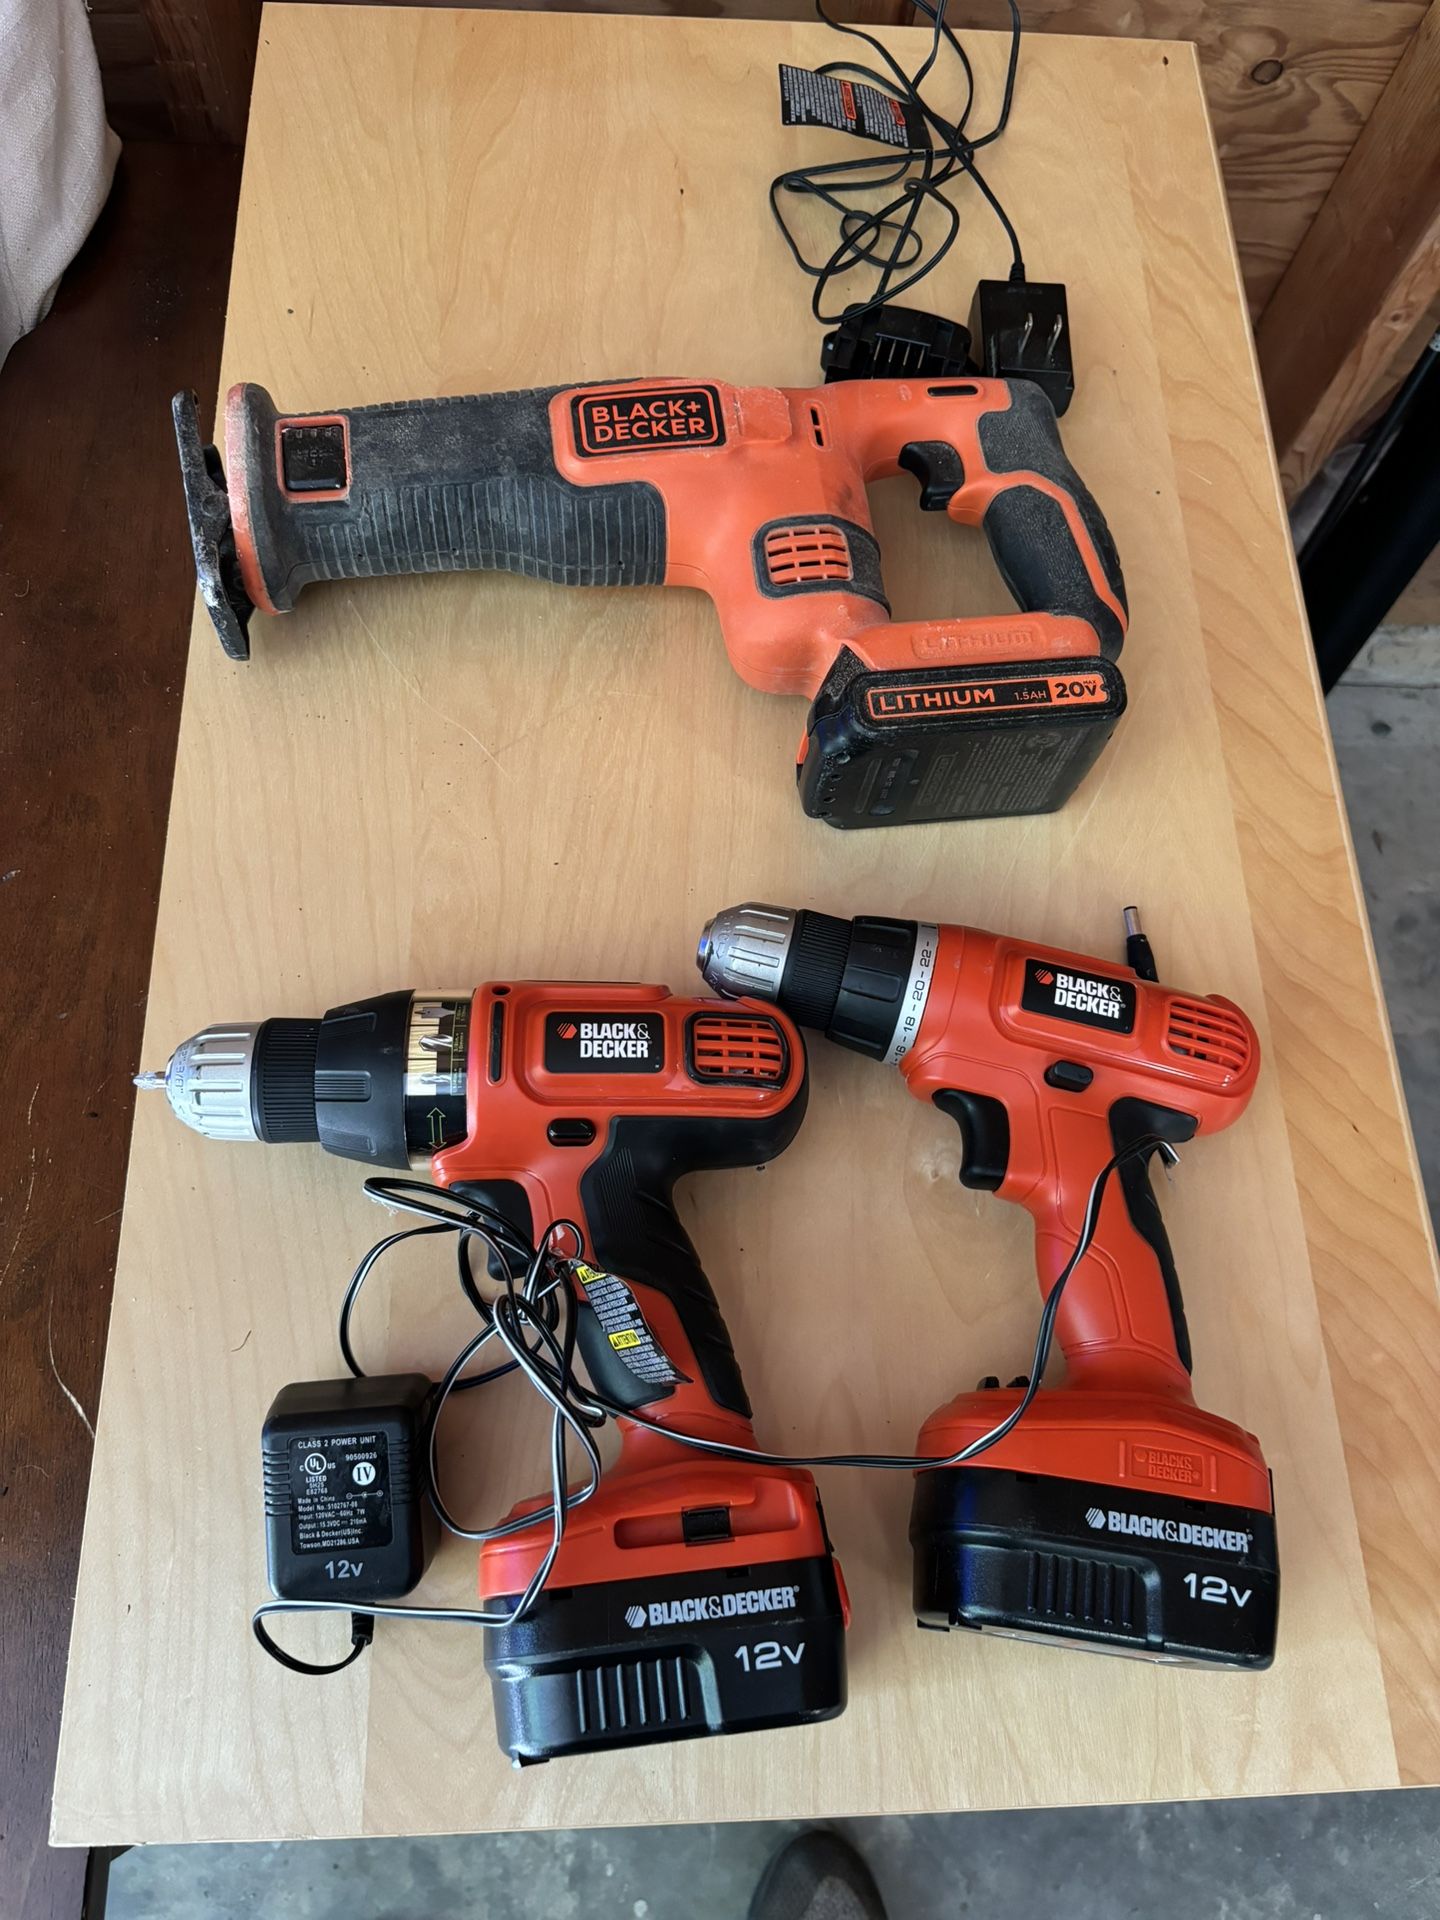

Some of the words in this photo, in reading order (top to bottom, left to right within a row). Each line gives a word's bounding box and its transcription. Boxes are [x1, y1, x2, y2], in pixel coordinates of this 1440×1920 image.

[591, 399, 701, 424] BLACK+
[594, 417, 707, 443] DECKER
[879, 687, 996, 712] LITHIUM
[1013, 690, 1047, 702] 1.5AH
[903, 1016, 916, 1033] 18
[912, 979, 926, 1002] 20
[919, 949, 932, 968] 22
[1053, 988, 1120, 1020] DECKER
[580, 1040, 649, 1058] DECKER
[297, 1440, 321, 1449] CLASS
[323, 1439, 329, 1447] 2
[331, 1437, 357, 1446] POWER
[359, 1435, 377, 1444] UNIT
[305, 1475, 327, 1484] LISTED
[1148, 1464, 1192, 1483] DECKER
[299, 1531, 316, 1539] Black
